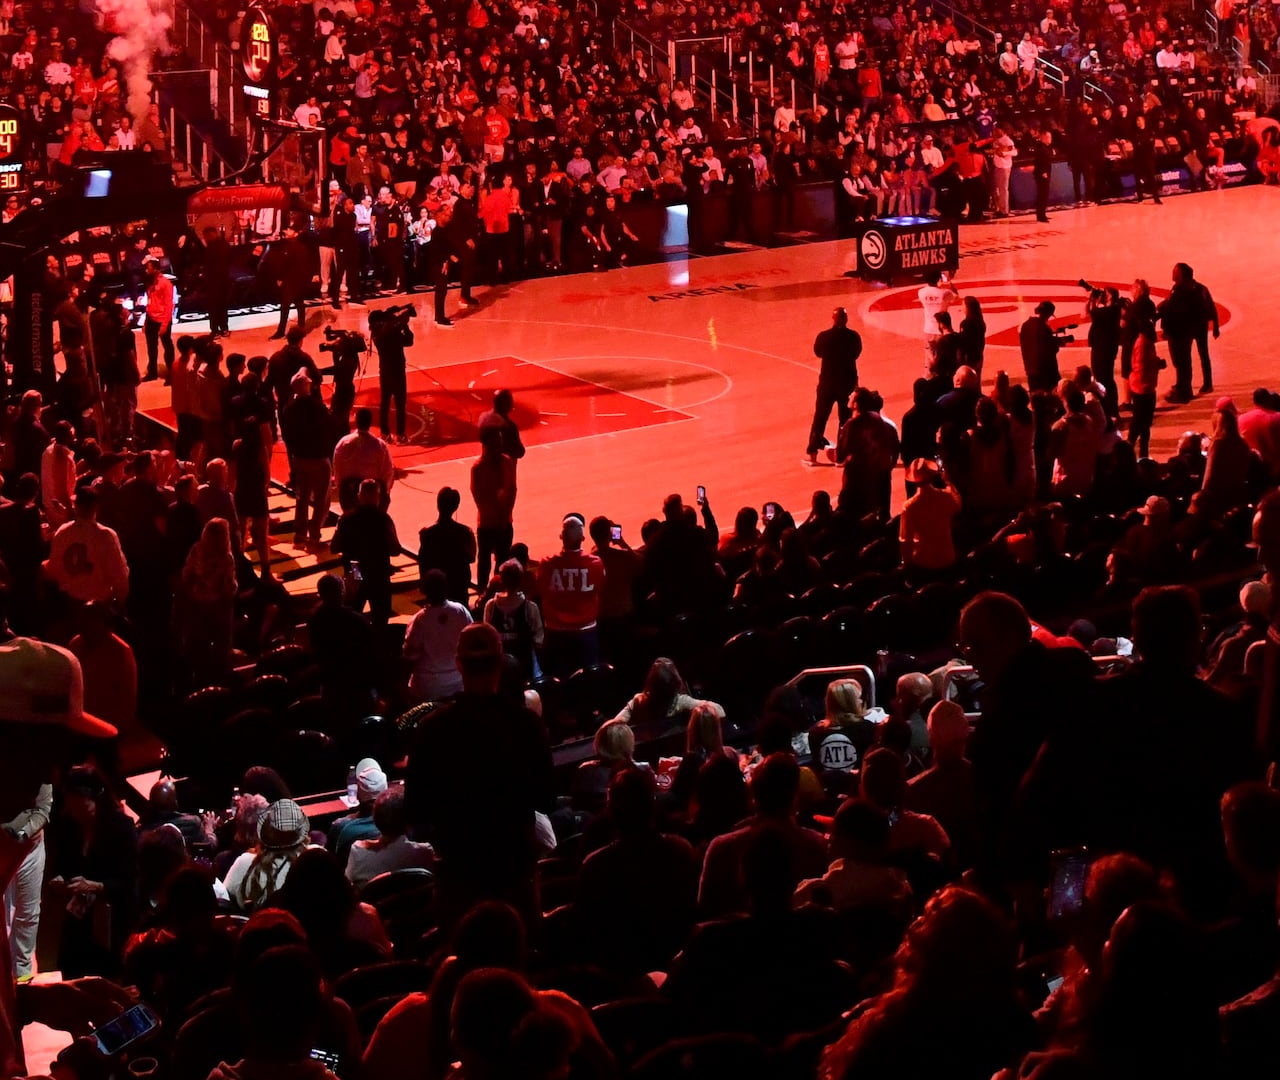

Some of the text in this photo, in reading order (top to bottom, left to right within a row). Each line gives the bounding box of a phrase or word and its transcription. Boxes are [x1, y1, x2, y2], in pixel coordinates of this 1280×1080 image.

[894, 229, 953, 252] ATLANTA
[901, 248, 946, 269] HAWKS
[647, 282, 760, 302] ARENA
[549, 567, 595, 592] ATL
[824, 745, 853, 763] ATL
